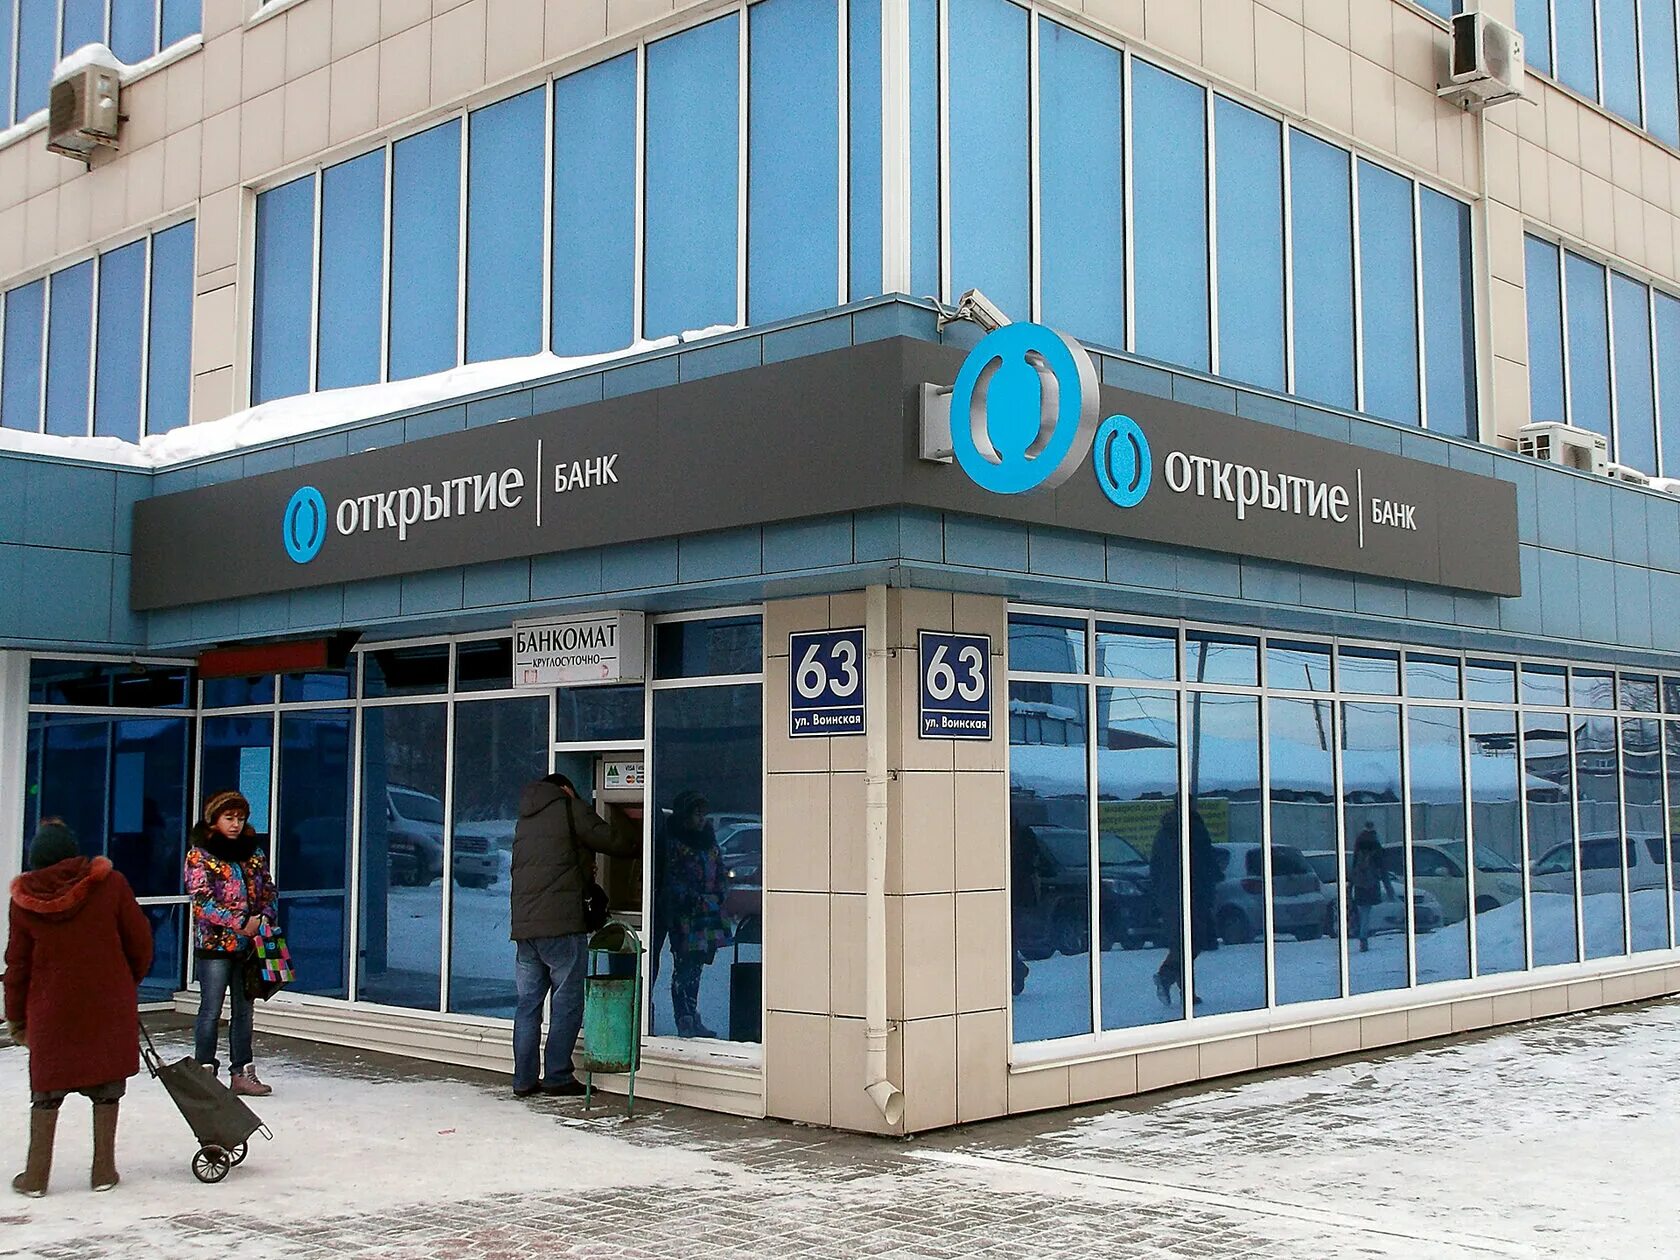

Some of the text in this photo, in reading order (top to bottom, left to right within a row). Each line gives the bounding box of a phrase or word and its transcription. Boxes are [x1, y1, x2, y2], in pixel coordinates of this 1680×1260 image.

[336, 453, 618, 541] открытие БАНК
[1164, 451, 1417, 530] открытие БАНК
[517, 624, 617, 653] БАНКОМАТ
[533, 653, 600, 668] КРУГЛОСУТОЧНО
[796, 640, 858, 699] 63
[926, 645, 985, 702] 63
[794, 713, 861, 729] ул. Воинская
[925, 716, 987, 731] ул. Воинская
